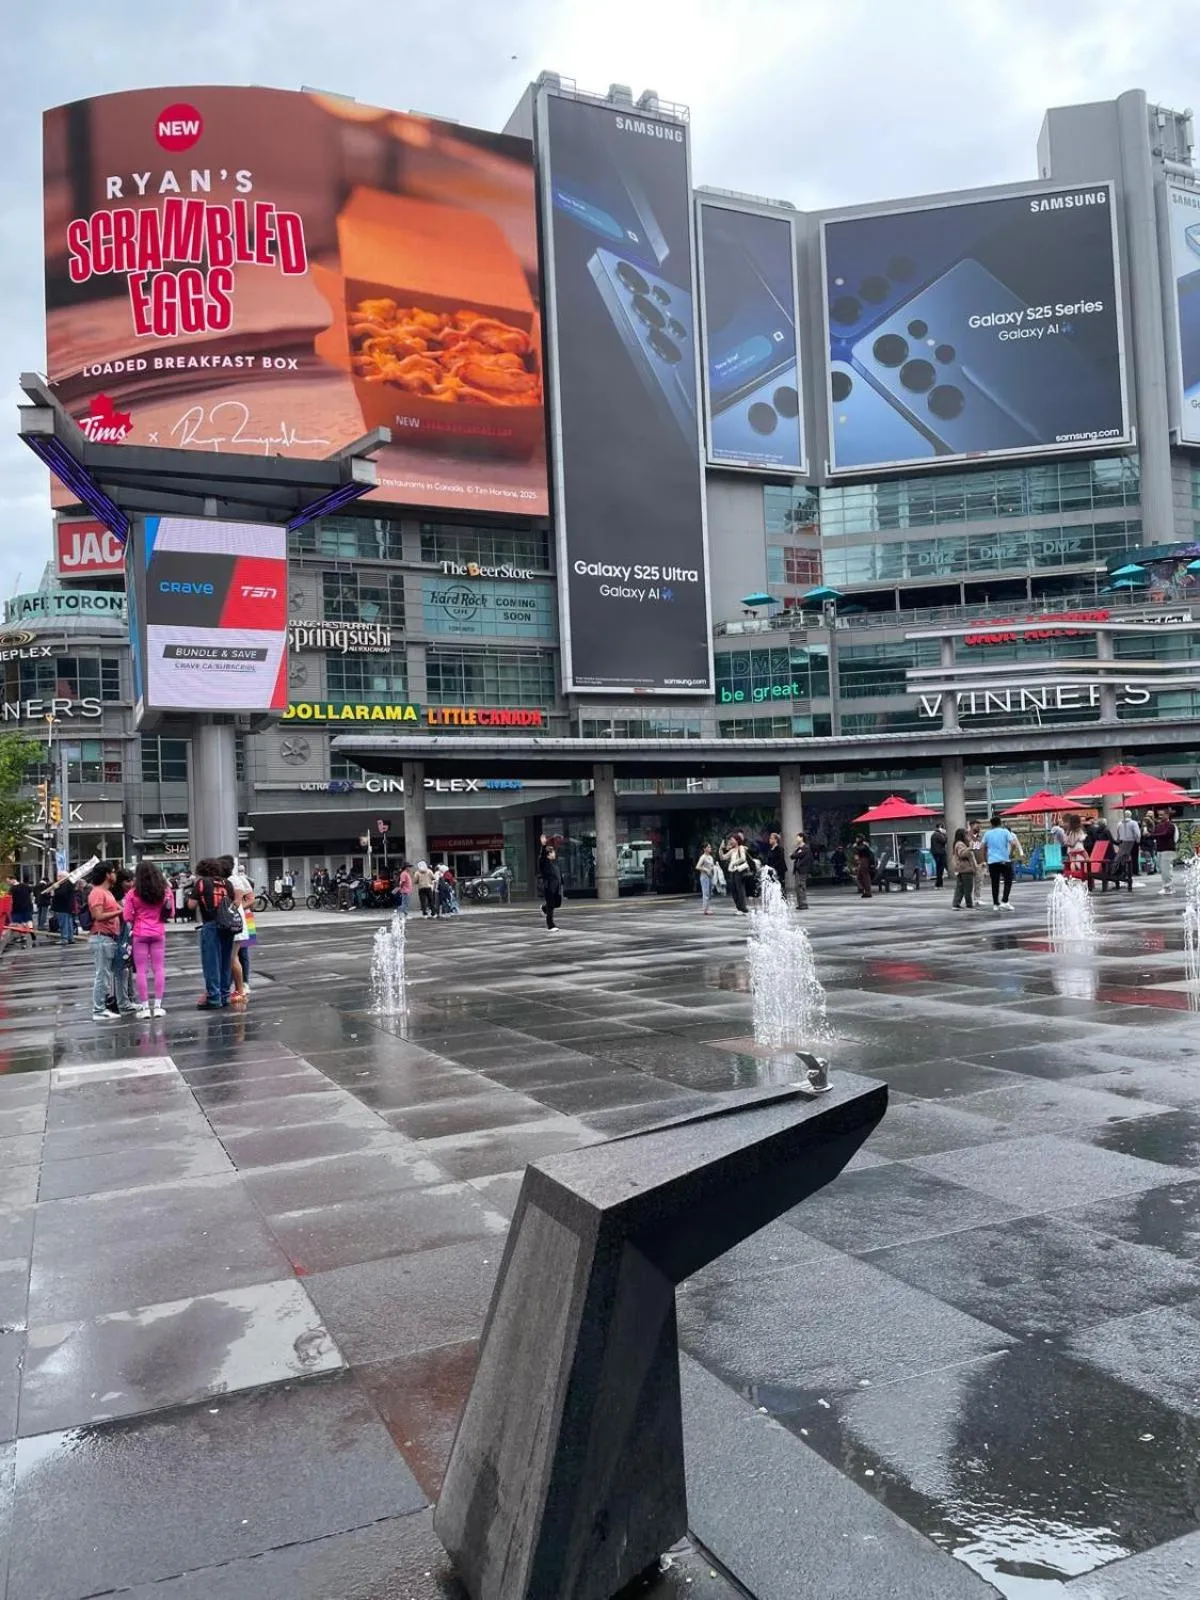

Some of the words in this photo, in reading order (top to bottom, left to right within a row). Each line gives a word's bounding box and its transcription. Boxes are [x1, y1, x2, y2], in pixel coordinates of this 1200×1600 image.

[158, 120, 200, 137] NEW
[615, 115, 684, 143] SAMSUNG
[105, 169, 253, 200] RYAN'S
[1029, 191, 1107, 213] SAMSUNG
[66, 196, 308, 284] SCRAMBLED
[128, 266, 235, 338] EGGS
[968, 310, 1024, 329] Galaxy
[1026, 305, 1053, 322] S25
[1055, 300, 1104, 317] Series
[998, 325, 1044, 342] Galaxy
[1047, 324, 1060, 335] AI
[82, 358, 148, 378] LOADED
[154, 355, 256, 370] BREAKFAST
[262, 356, 299, 371] BOX
[79, 415, 129, 443] Tims
[395, 415, 421, 429] NEW
[1055, 429, 1120, 443] samsung.com
[440, 560, 467, 575] The
[466, 562, 501, 577] Beer
[499, 564, 535, 580] Store
[573, 560, 632, 582] Galaxy
[633, 564, 660, 581] S25
[661, 566, 699, 583] Ultra
[430, 591, 460, 606] Hard
[460, 592, 489, 608] Rock
[599, 584, 646, 602] Galaxy
[648, 586, 660, 599] AI
[496, 598, 537, 609] COMING
[503, 611, 532, 622] SOON
[175, 647, 219, 658] BUNDLE
[220, 648, 229, 659] &
[231, 649, 258, 660] SAVE
[663, 678, 707, 687] samsung.com
[721, 685, 745, 702] be
[753, 680, 805, 702] great.
[281, 703, 418, 722] DOLLARAMA
[365, 778, 479, 794] CINPLEX
